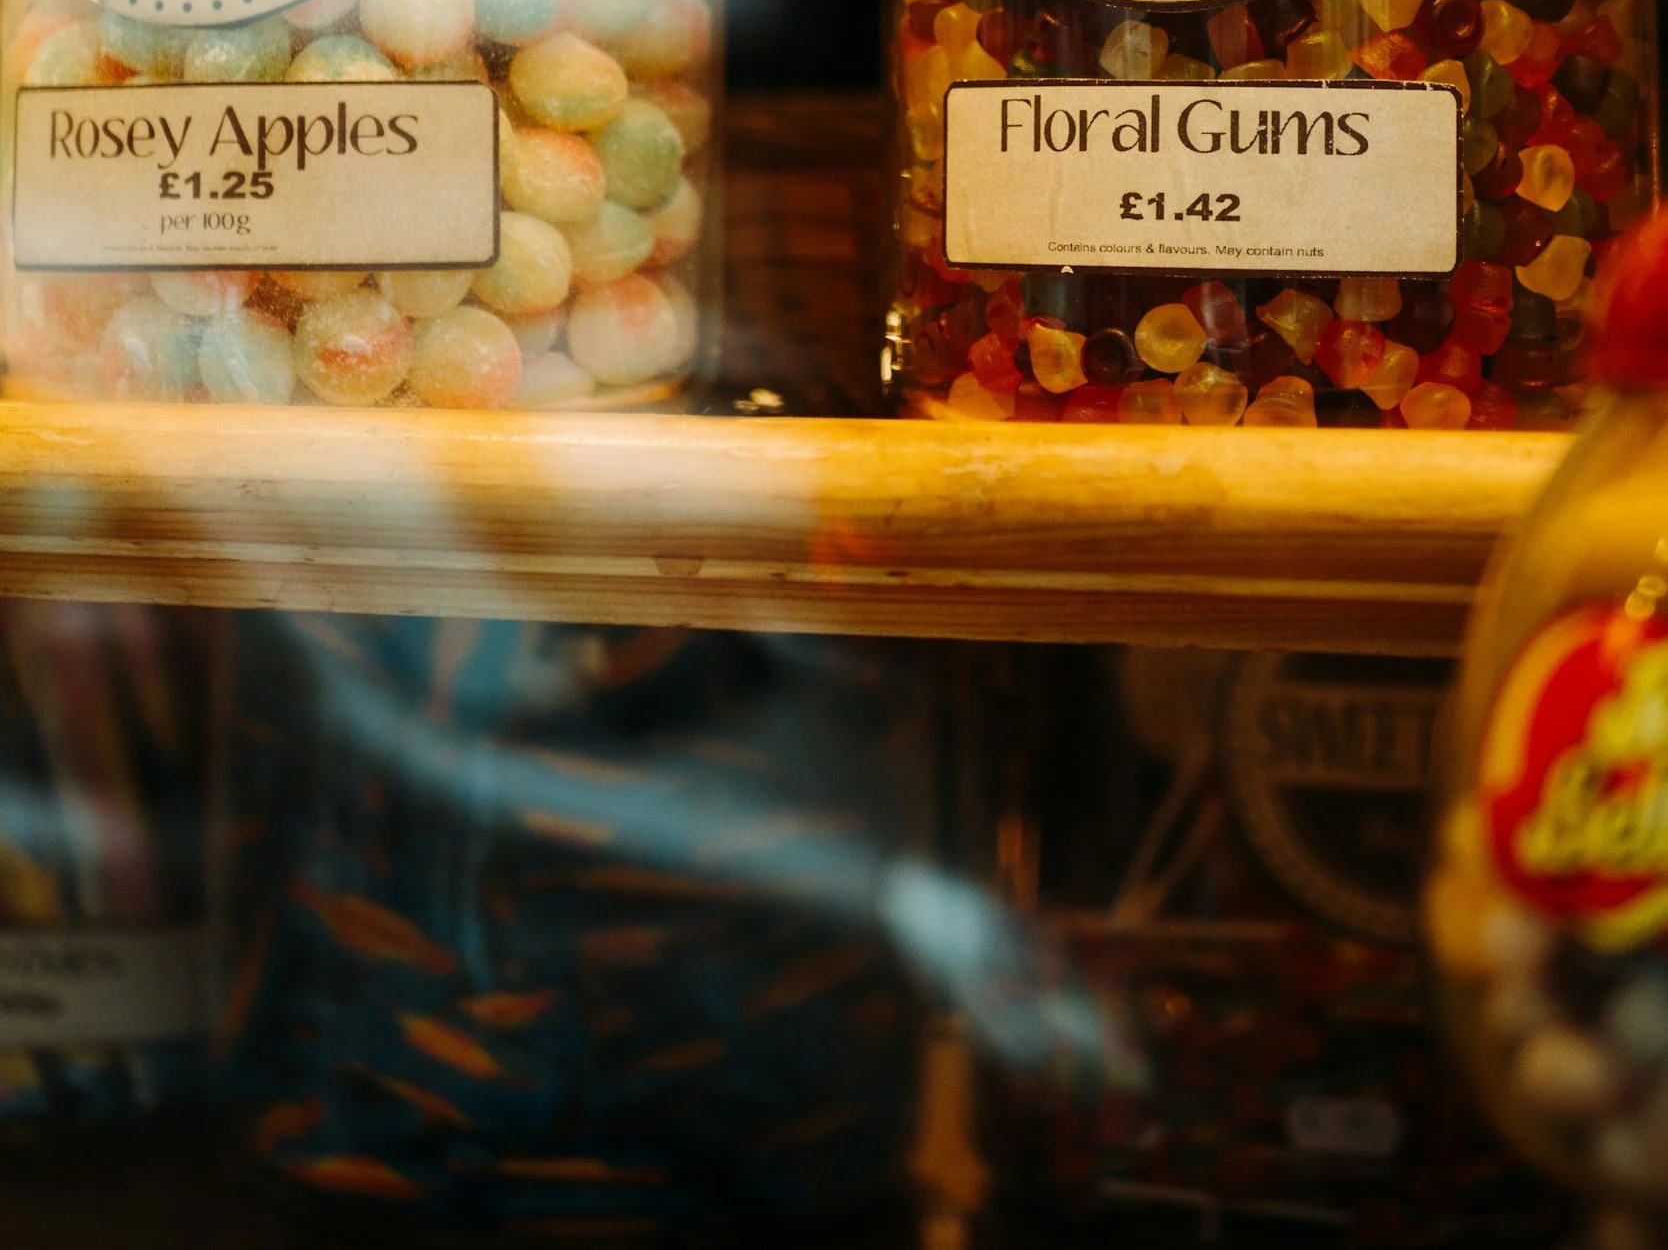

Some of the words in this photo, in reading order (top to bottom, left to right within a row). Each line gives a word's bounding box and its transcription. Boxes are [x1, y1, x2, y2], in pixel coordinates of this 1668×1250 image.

[49, 109, 193, 169] Rosey
[208, 101, 420, 171] Apples
[999, 94, 1161, 154] Floral
[1177, 98, 1371, 157] Gums
[158, 170, 275, 200] £1.25
[1119, 191, 1242, 222] £1.42
[159, 212, 197, 235] per
[202, 212, 252, 236] 100g
[1047, 241, 1096, 253] Contains
[1099, 243, 1142, 254] colours
[1145, 243, 1155, 254] &
[1158, 243, 1211, 256] flavours.
[1215, 245, 1243, 258] May
[1246, 246, 1293, 257] contain
[1297, 247, 1325, 257] nuts
